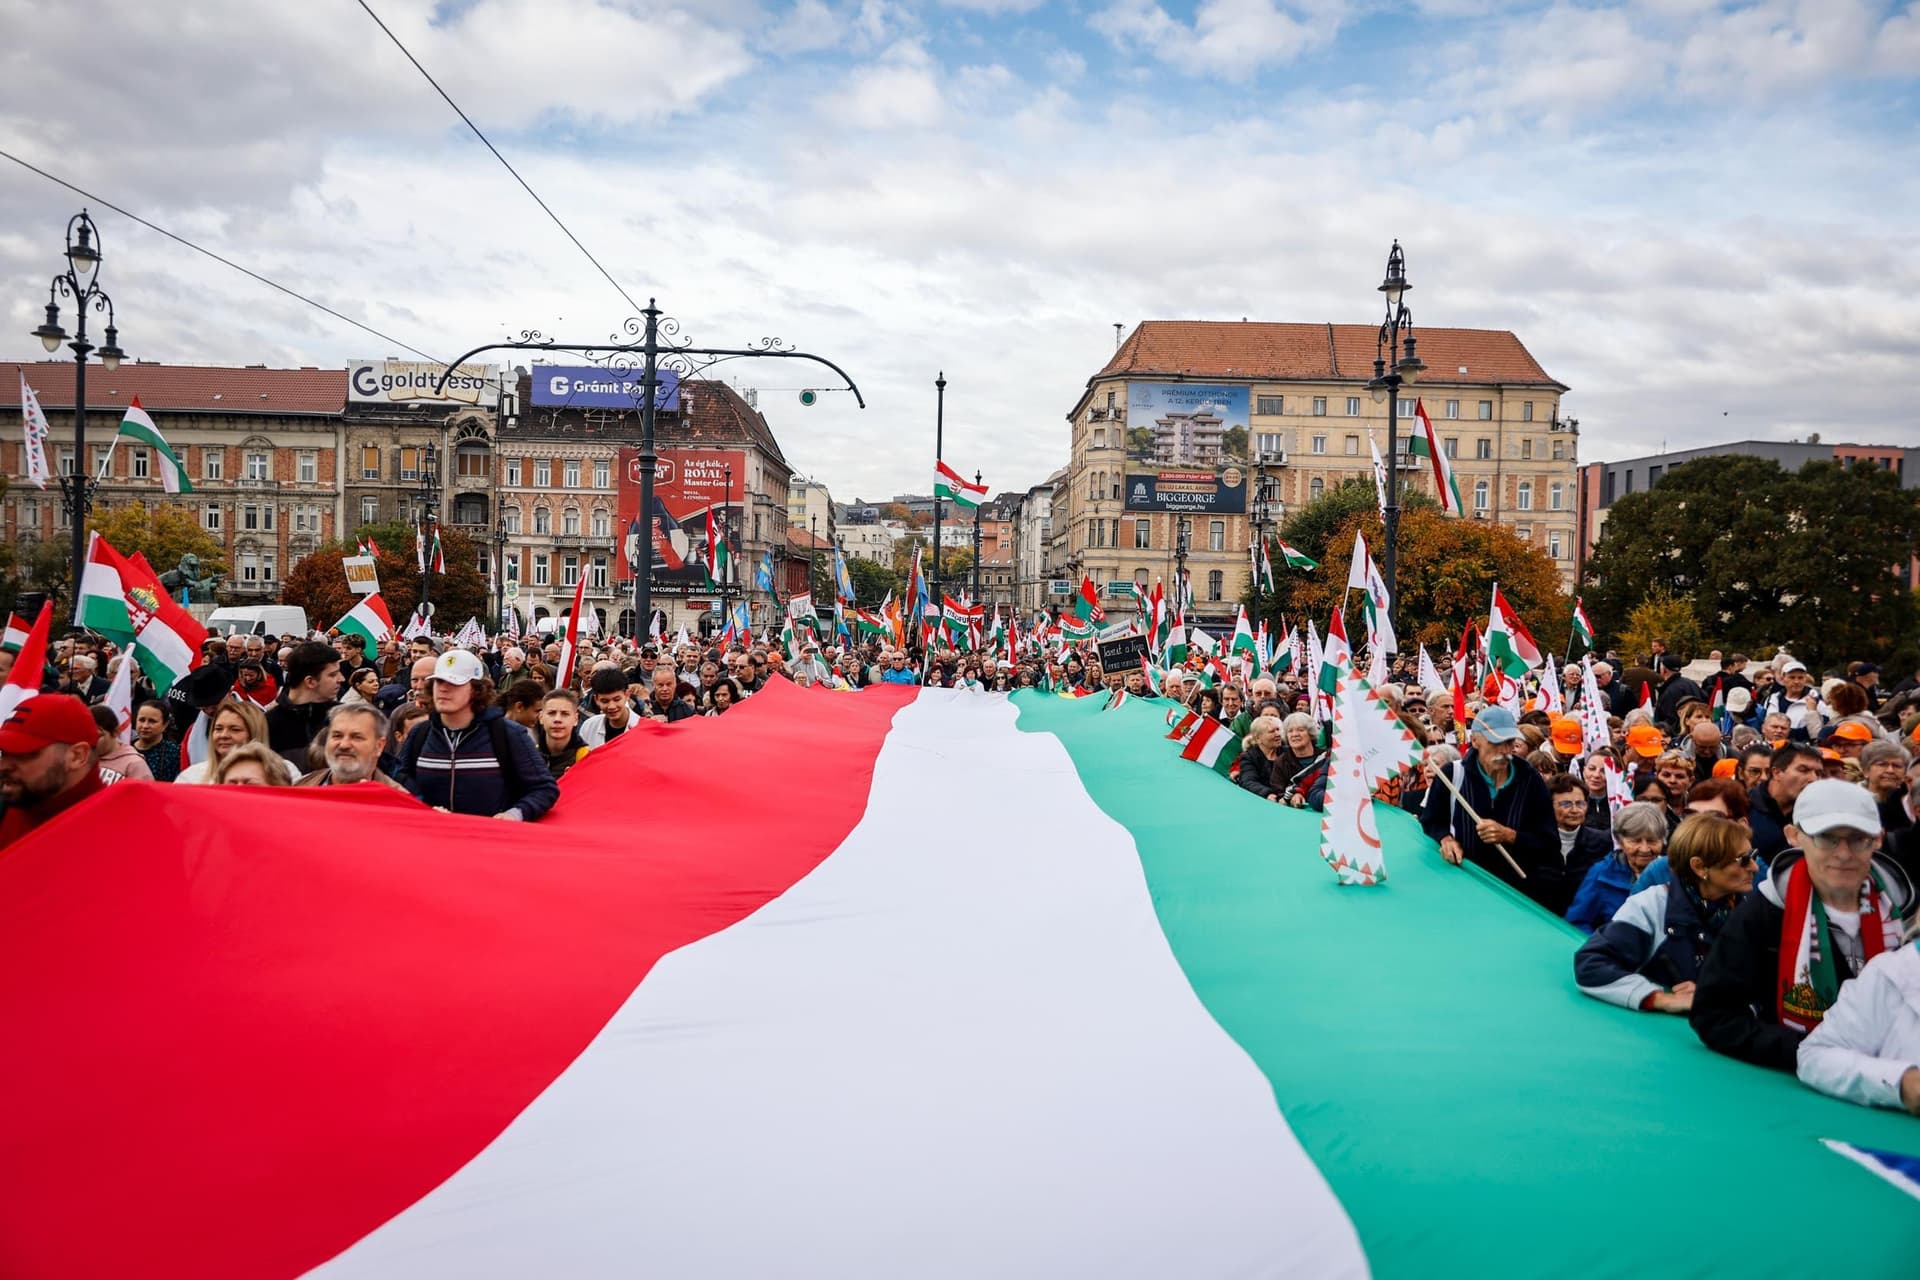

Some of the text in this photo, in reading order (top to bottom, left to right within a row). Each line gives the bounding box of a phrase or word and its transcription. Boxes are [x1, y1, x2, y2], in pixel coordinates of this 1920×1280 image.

[574, 380, 618, 393] Gránit
[684, 469, 722, 478] ROYAL
[683, 478, 712, 487] Master
[1156, 493, 1215, 503] BIGGEORGE
[1166, 503, 1206, 511] biggeorge.hu
